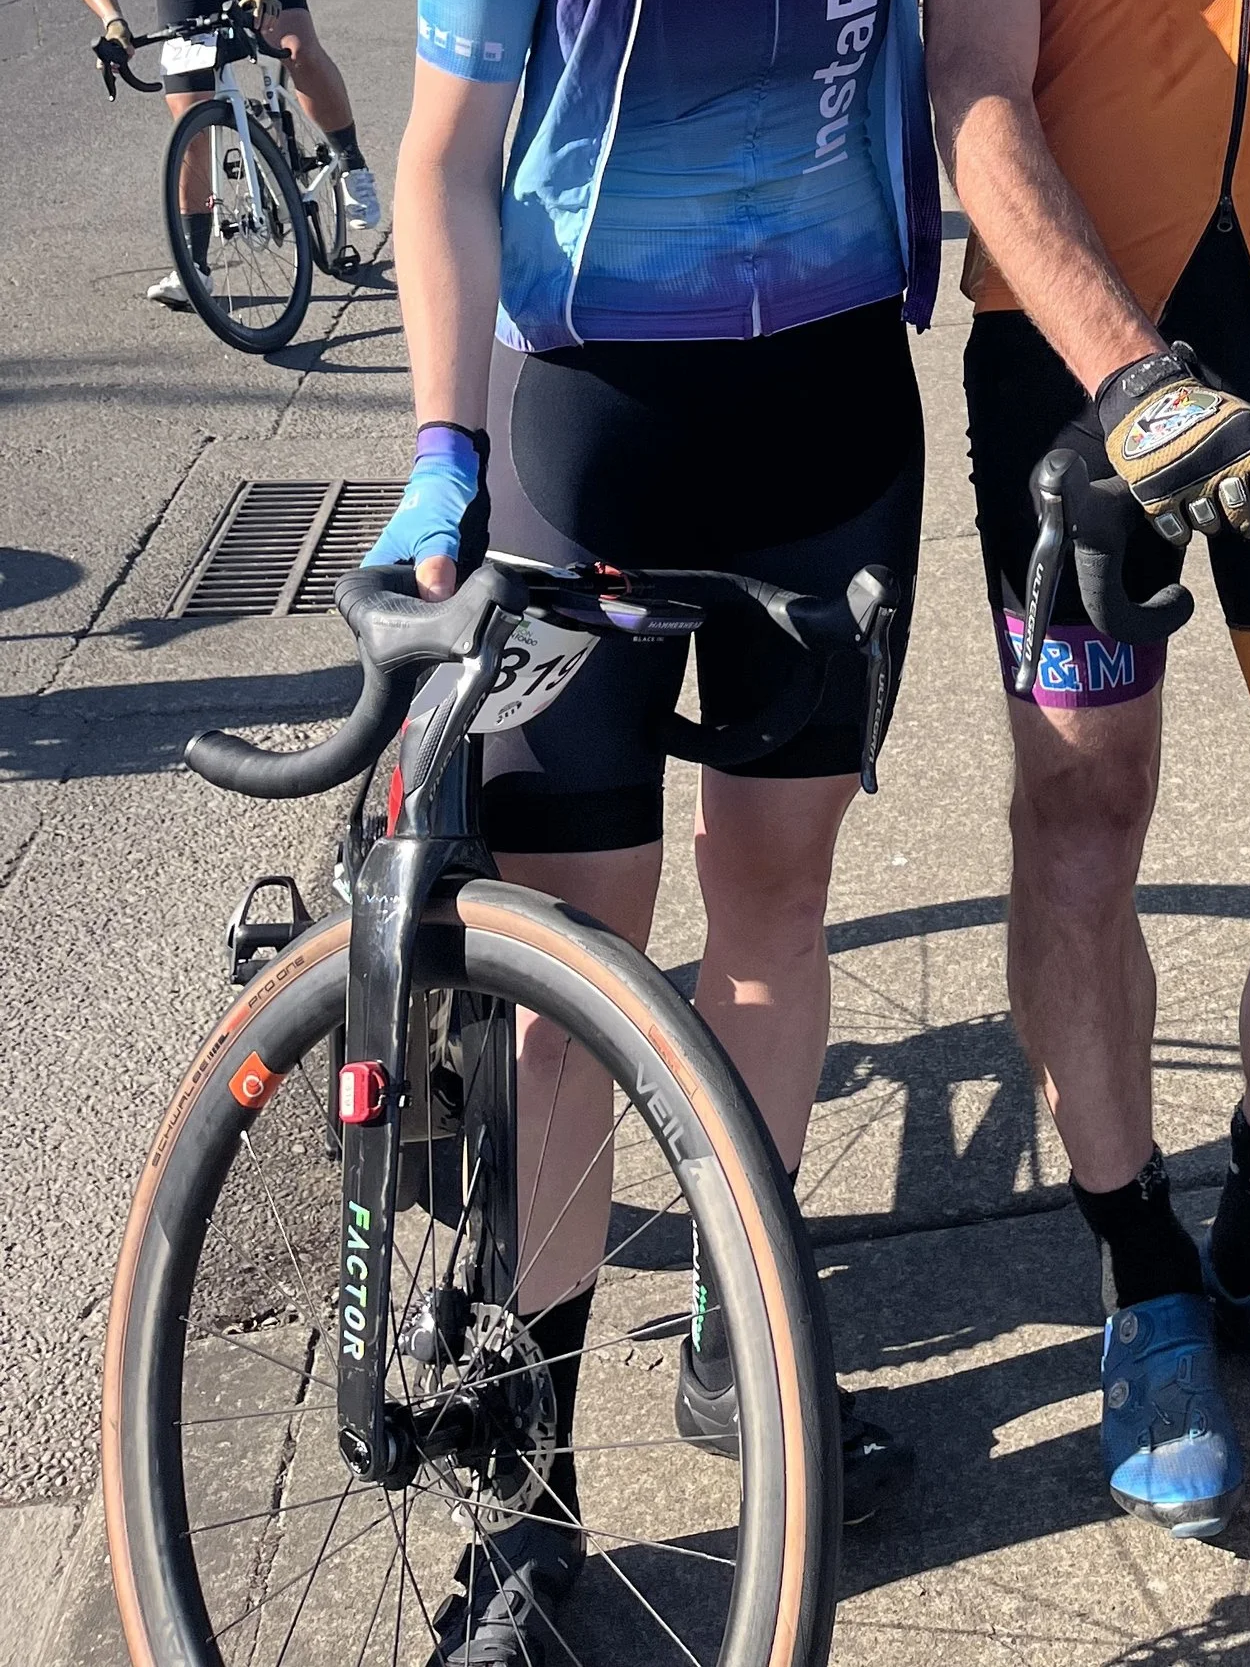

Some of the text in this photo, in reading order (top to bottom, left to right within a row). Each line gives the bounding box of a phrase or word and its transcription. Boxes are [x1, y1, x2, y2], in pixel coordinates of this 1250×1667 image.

[1025, 562, 1044, 662] ULTEGRA
[489, 646, 589, 697] 319
[635, 1061, 685, 1162] VEIL
[343, 1200, 371, 1361] FACTOR
